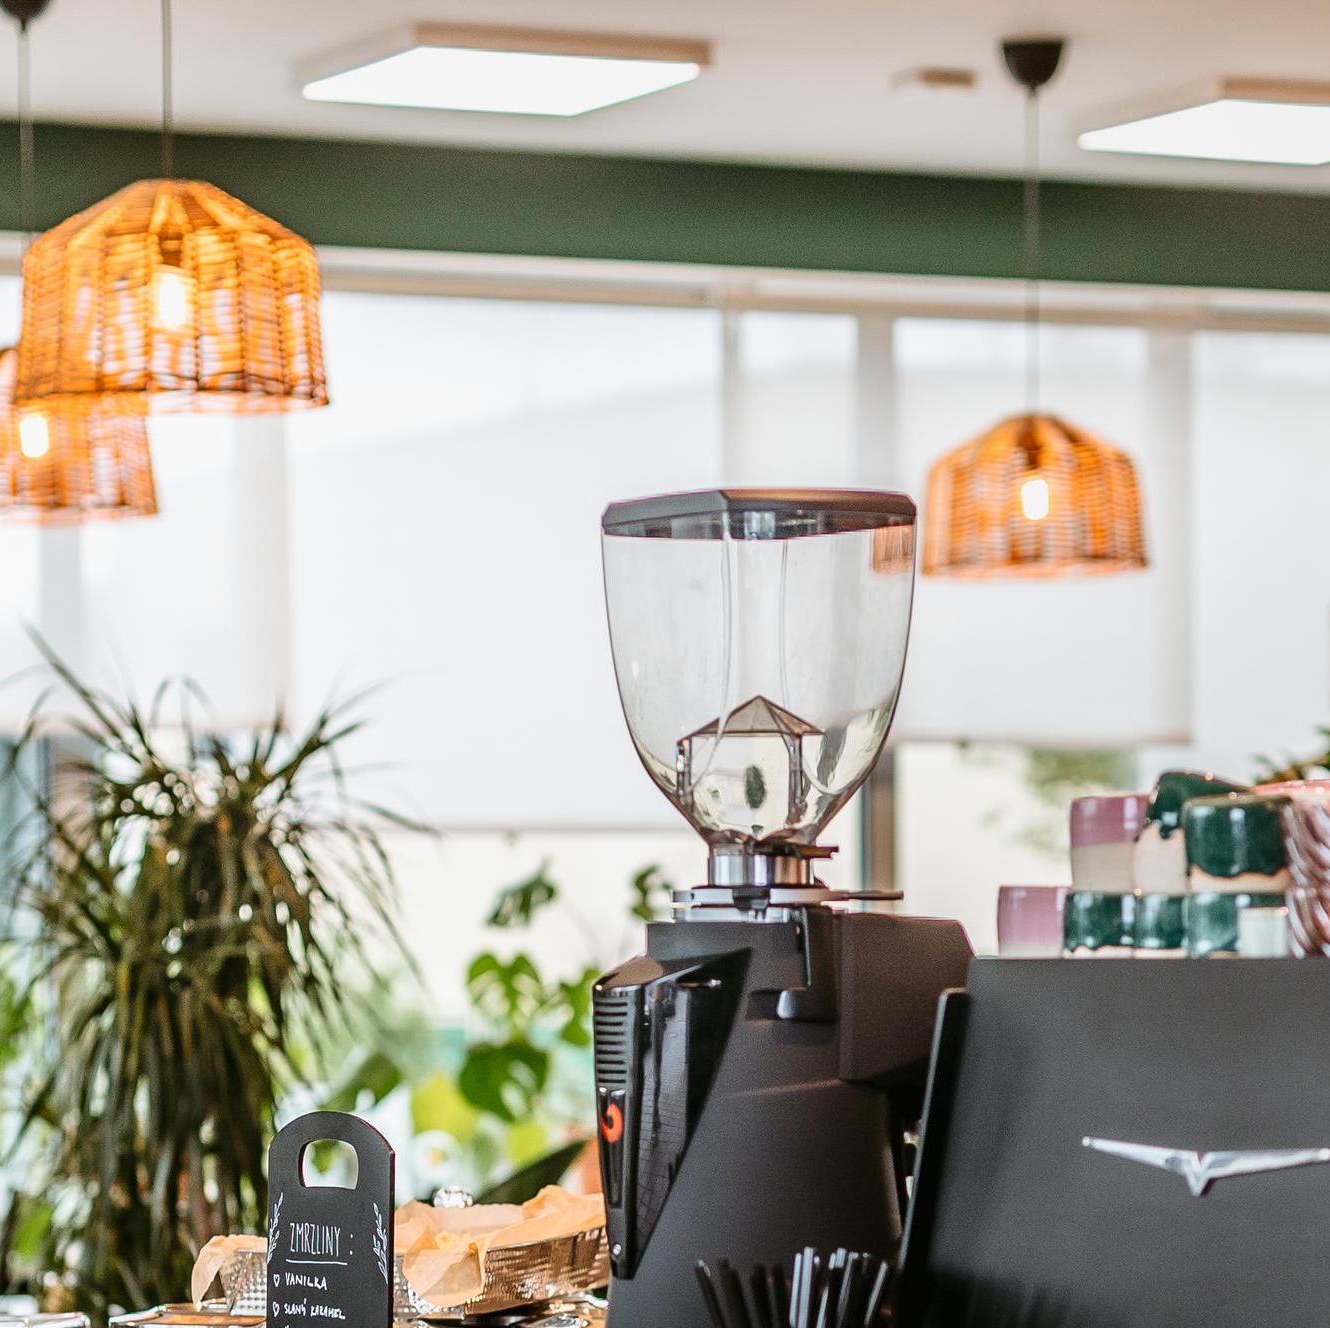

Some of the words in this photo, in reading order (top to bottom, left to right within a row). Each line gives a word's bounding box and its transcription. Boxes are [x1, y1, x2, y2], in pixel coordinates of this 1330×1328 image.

[290, 1222, 341, 1257] ZMRZLINY
[285, 1272, 328, 1291] VANILKA
[310, 1305, 346, 1320] KARAMEL
